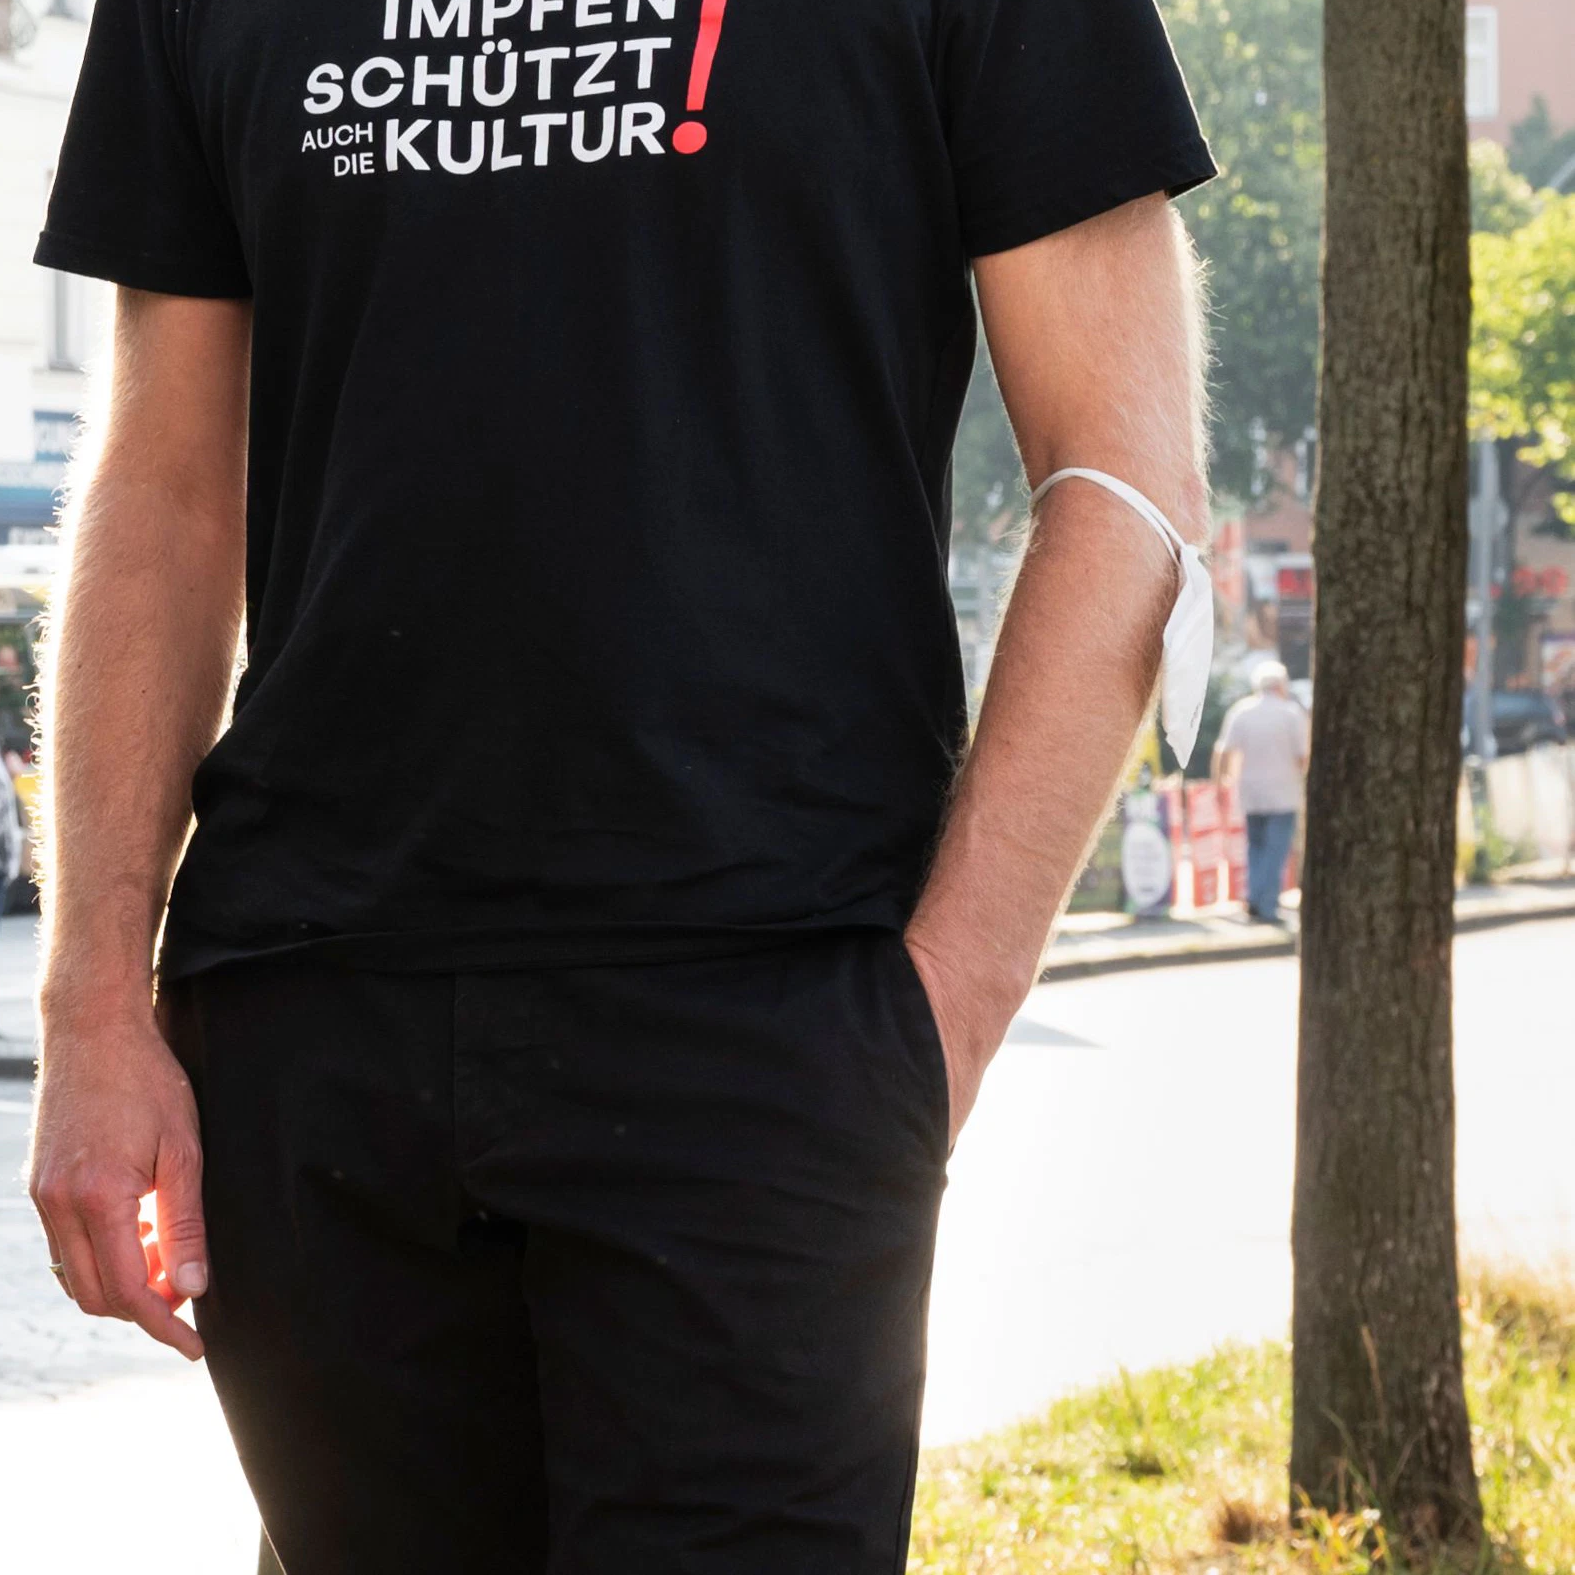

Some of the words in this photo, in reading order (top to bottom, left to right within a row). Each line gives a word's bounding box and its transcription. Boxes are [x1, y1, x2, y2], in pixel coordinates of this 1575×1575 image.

[303, 36, 673, 115] SCHÜTZT
[301, 121, 374, 153] AUCH
[333, 151, 375, 177] DIE
[385, 101, 667, 176] KULTUR
